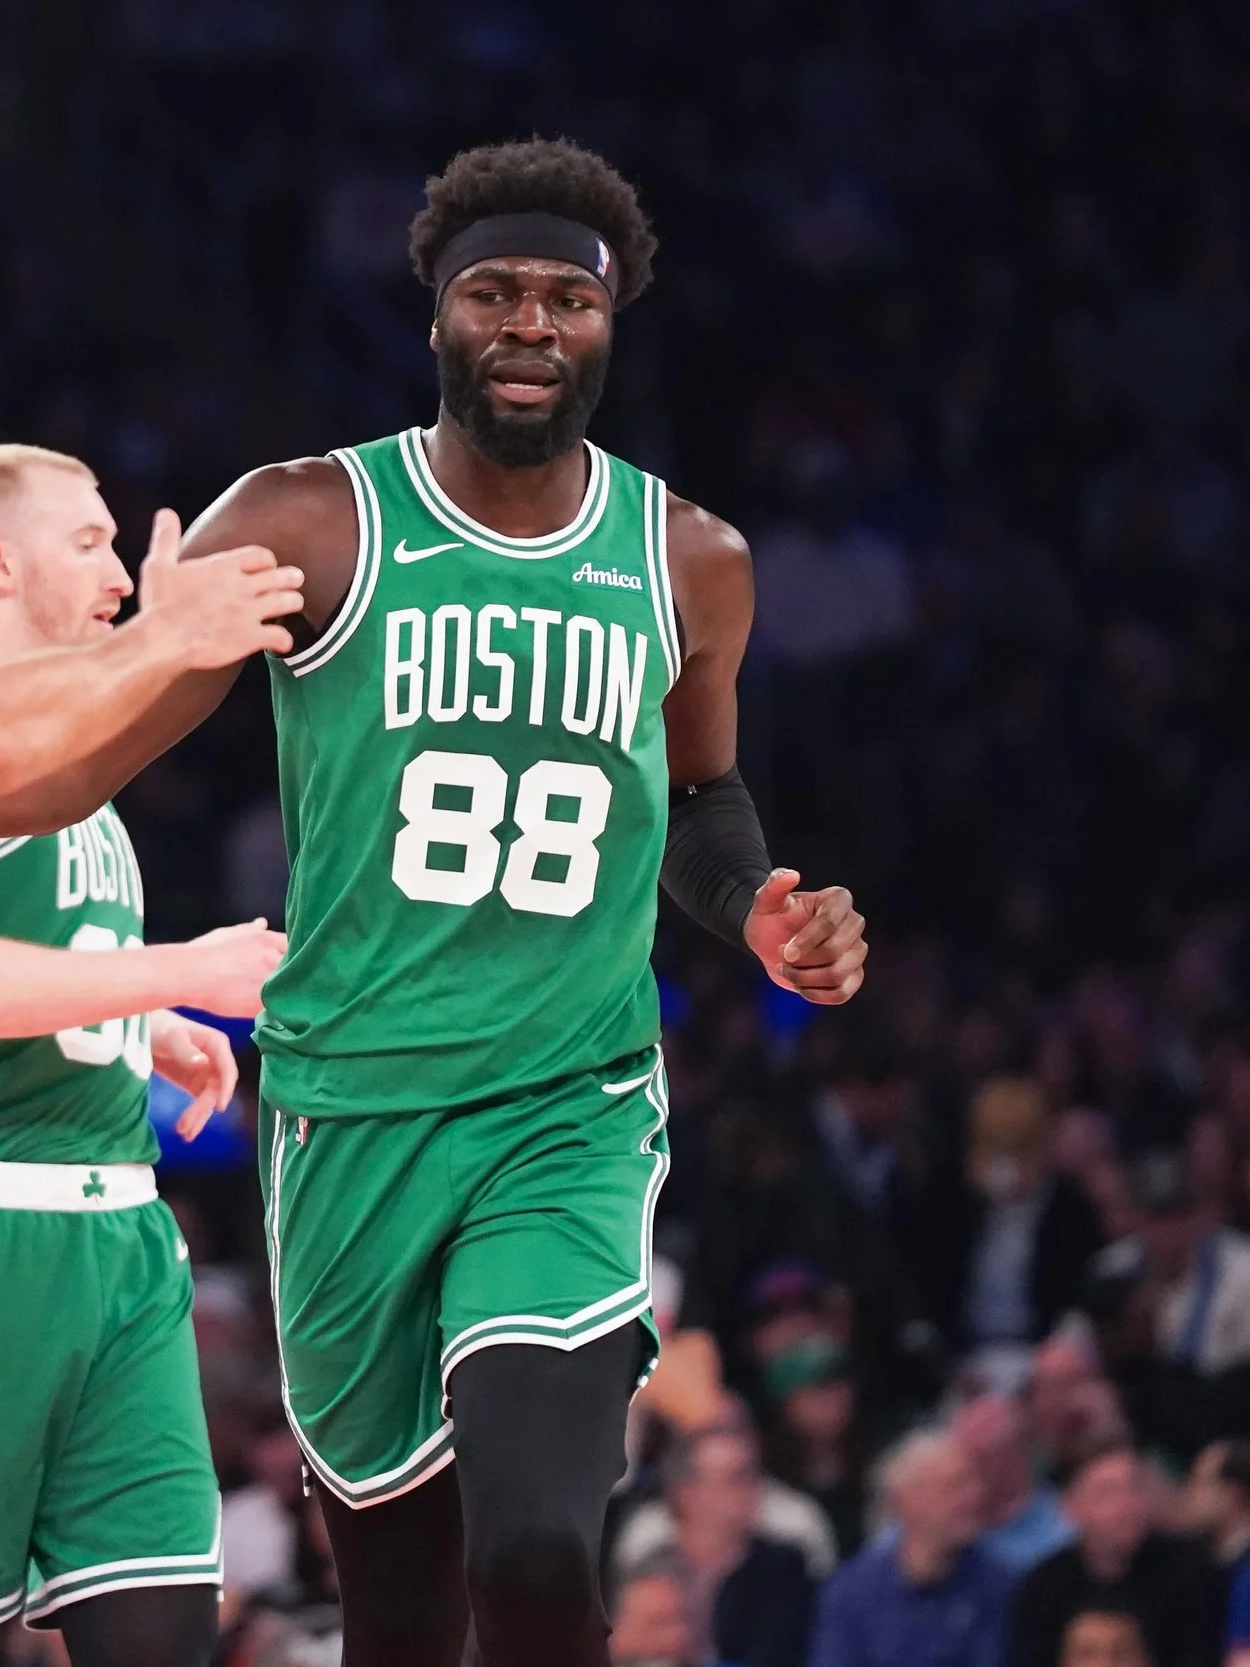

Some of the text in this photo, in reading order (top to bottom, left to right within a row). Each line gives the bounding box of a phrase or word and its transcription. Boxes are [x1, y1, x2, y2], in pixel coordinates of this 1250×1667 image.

[573, 562, 643, 590] Amica
[384, 604, 648, 752] BOSTON
[391, 750, 613, 917] 88
